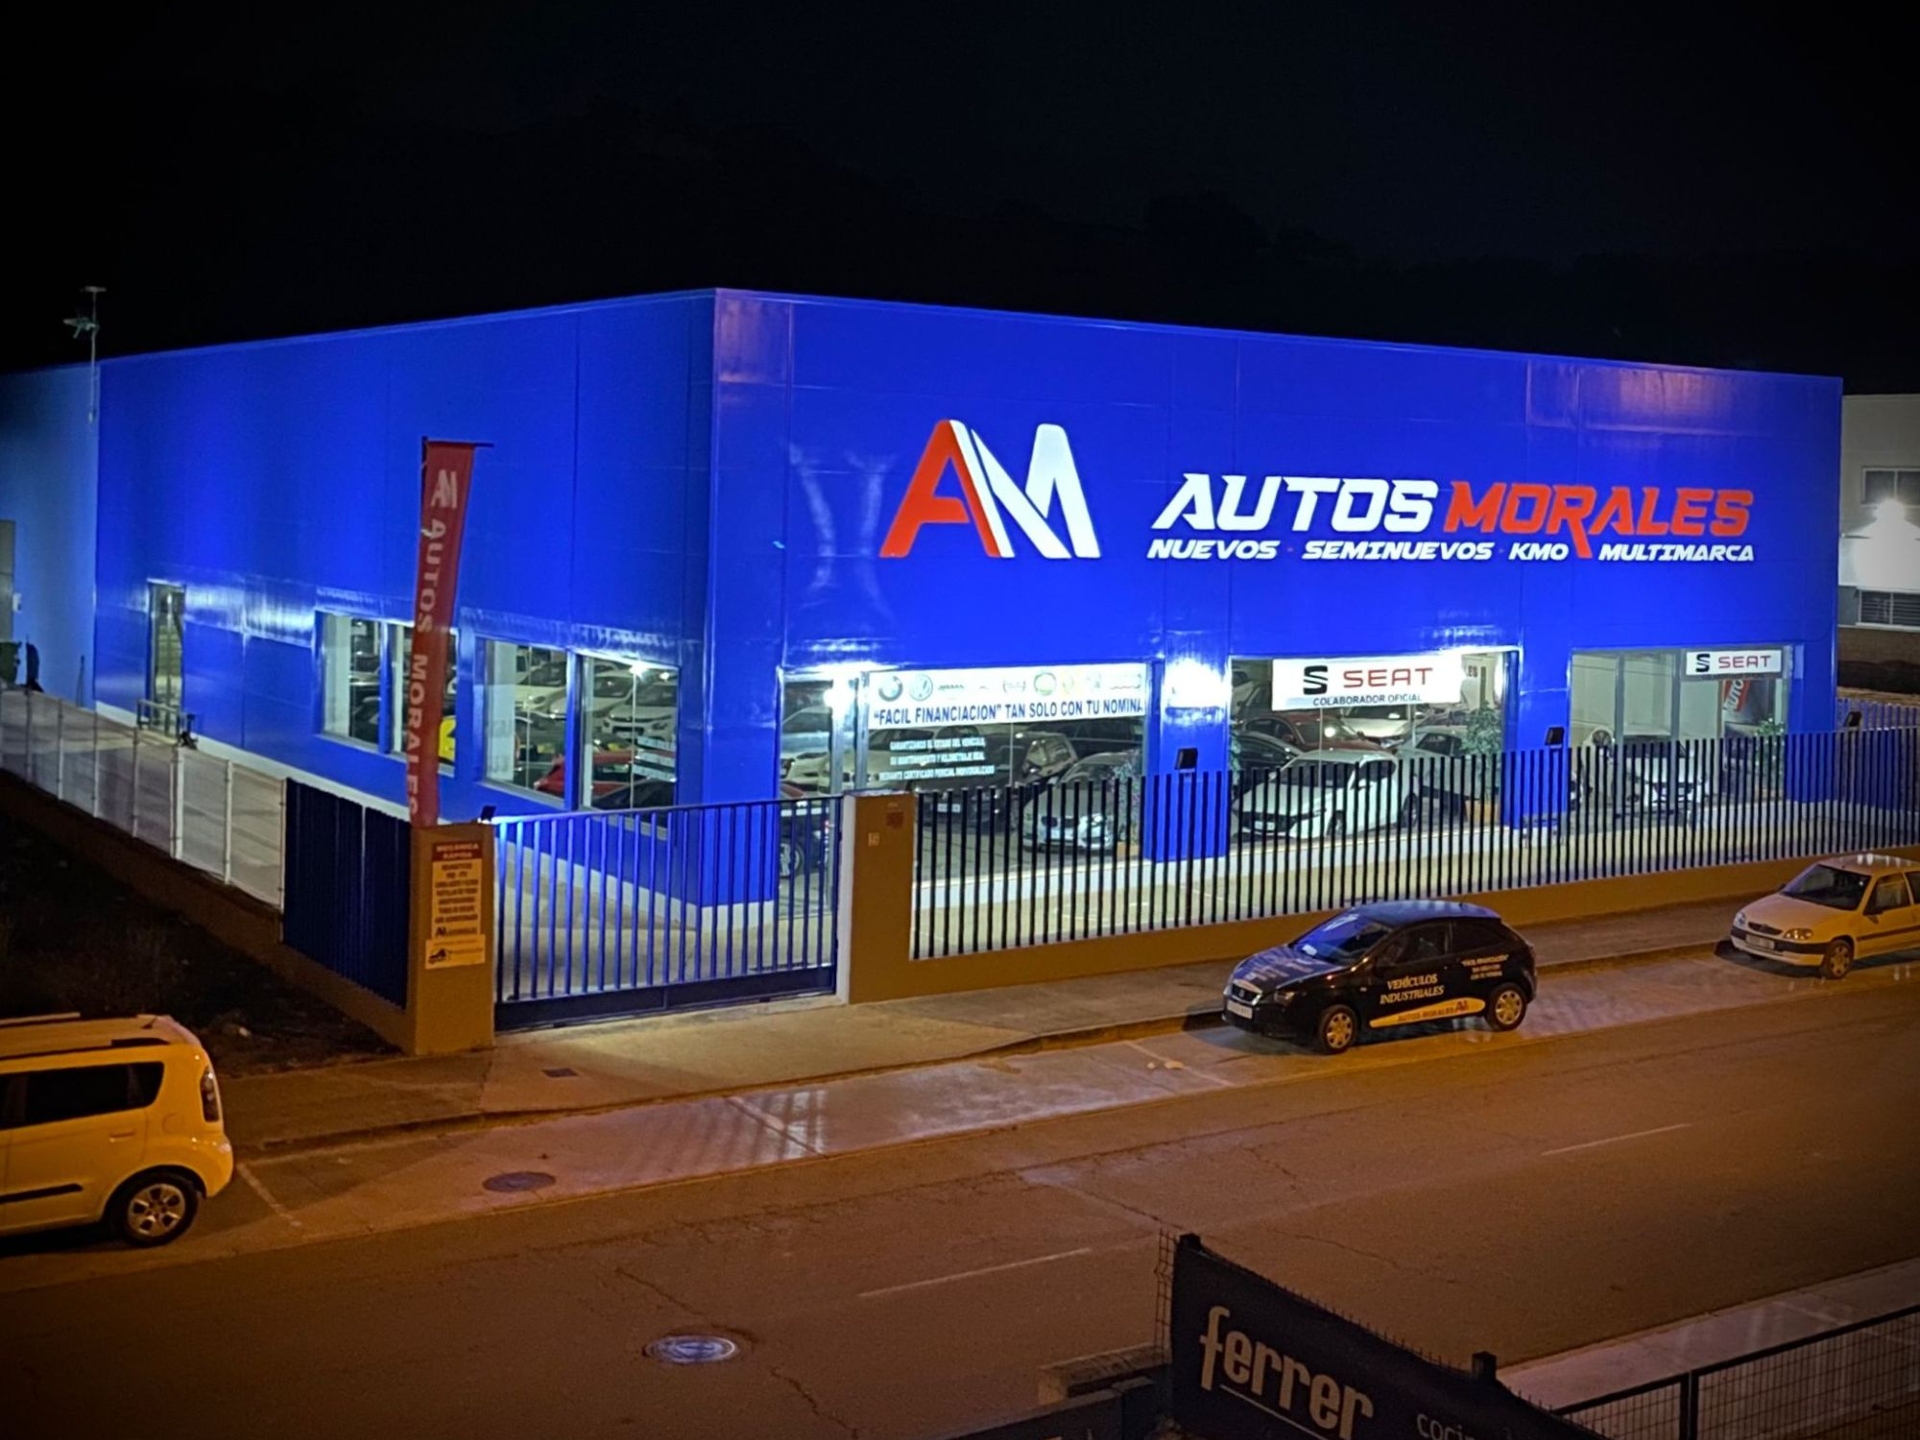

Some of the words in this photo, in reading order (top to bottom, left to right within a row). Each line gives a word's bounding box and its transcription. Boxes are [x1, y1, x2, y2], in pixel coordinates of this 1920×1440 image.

[883, 420, 1101, 559] AM
[1150, 472, 1439, 533] AUTOS
[1443, 481, 1754, 559] MORALES
[1146, 538, 1281, 560] NUEVOS
[1301, 540, 1495, 561] SEMINUEVOS
[1598, 542, 1755, 562] MULTIMARCA
[417, 518, 447, 632] AUTOS
[1718, 655, 1771, 669] SEAT
[1342, 667, 1434, 689] SEAT
[1004, 702, 1026, 719] TAN
[1028, 701, 1058, 718] SOLO
[1060, 700, 1083, 717] CON
[1086, 699, 1100, 715] TU
[1312, 694, 1386, 707] COLABORADOR
[1387, 692, 1422, 704] OFICIAL
[1379, 985, 1445, 1004] INDUSTRIALES
[1199, 1306, 1374, 1440] ferrer
